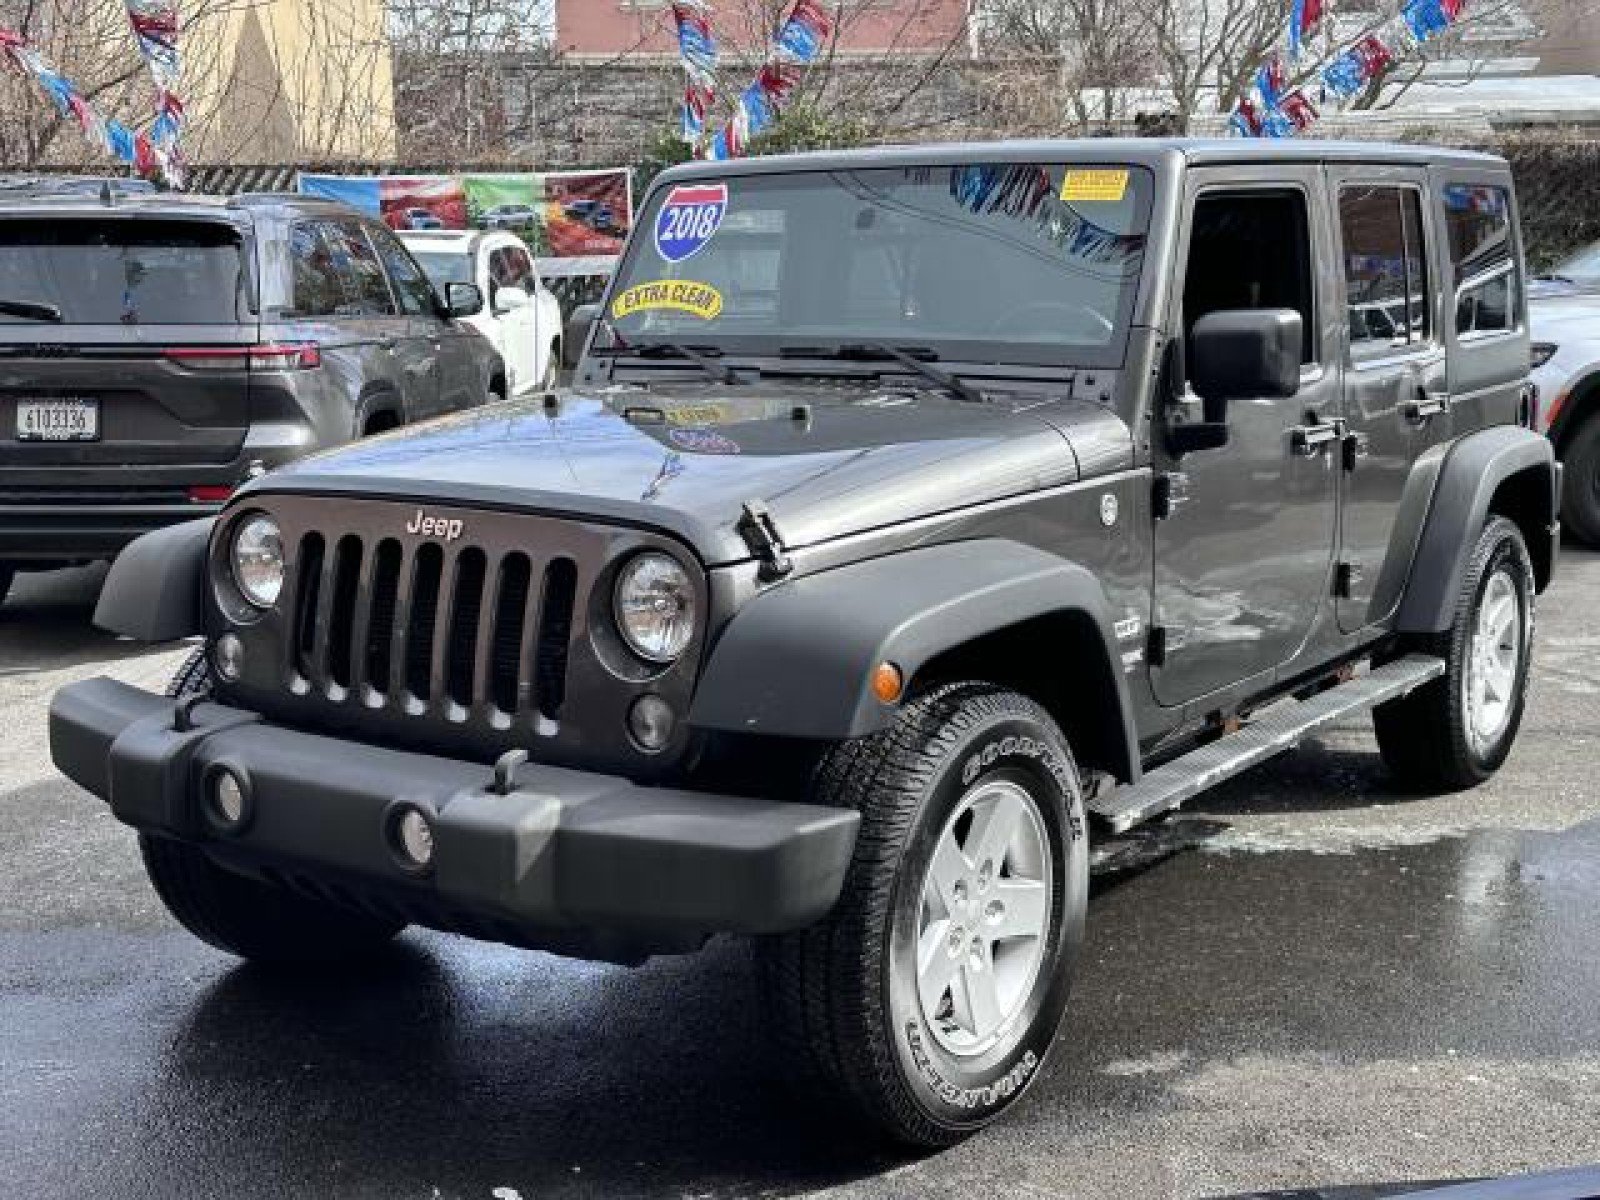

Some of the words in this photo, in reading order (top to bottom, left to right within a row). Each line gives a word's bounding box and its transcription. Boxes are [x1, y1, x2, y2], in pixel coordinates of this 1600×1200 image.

[659, 204, 718, 241] 2018
[624, 284, 668, 310] EXTRA
[671, 284, 717, 311] CLEAN
[406, 509, 463, 541] Jeep
